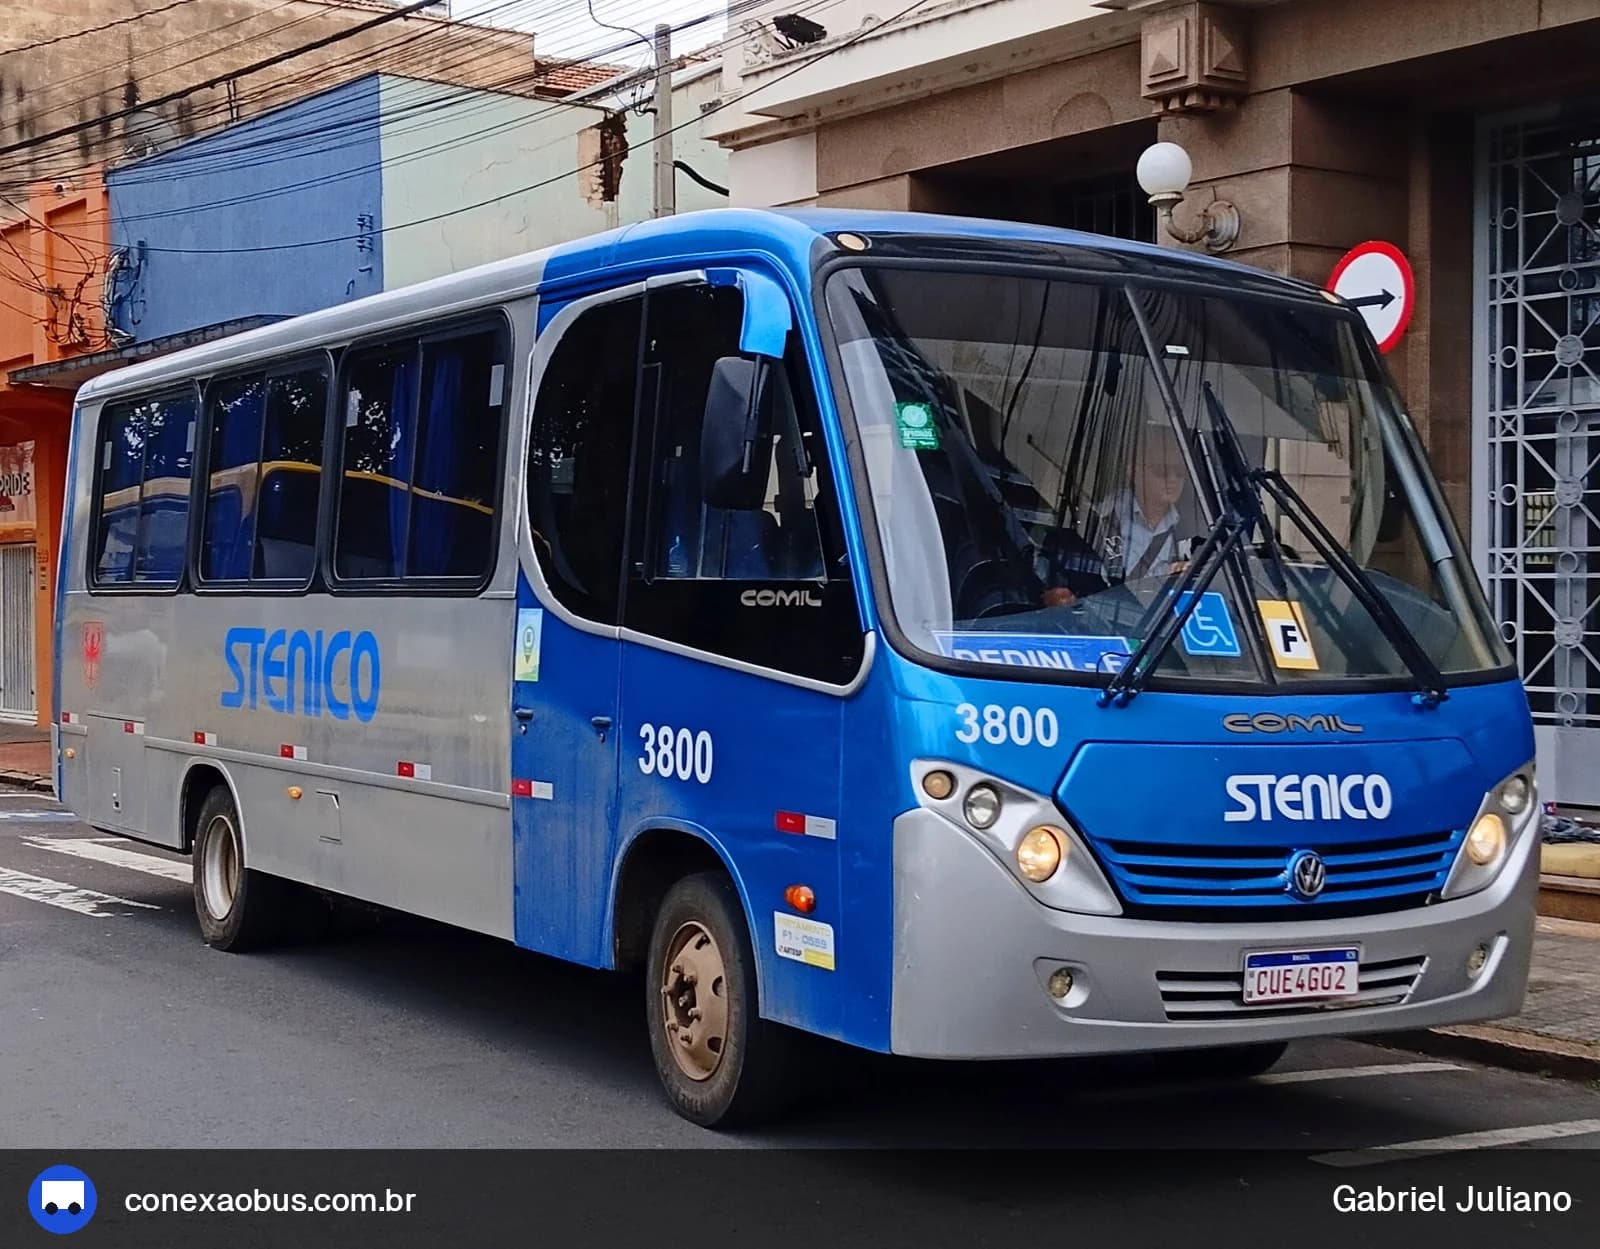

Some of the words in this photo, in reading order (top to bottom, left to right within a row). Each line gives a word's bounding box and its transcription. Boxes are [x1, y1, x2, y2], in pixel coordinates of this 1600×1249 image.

[740, 588, 823, 608] COMIL
[1280, 625, 1297, 652] F
[221, 627, 380, 722] STENICO
[955, 703, 1059, 748] 3800
[1223, 713, 1363, 734] COMIL
[638, 723, 713, 785] 3800
[1224, 774, 1391, 822] STENICO
[1256, 965, 1346, 996] CUE4G02
